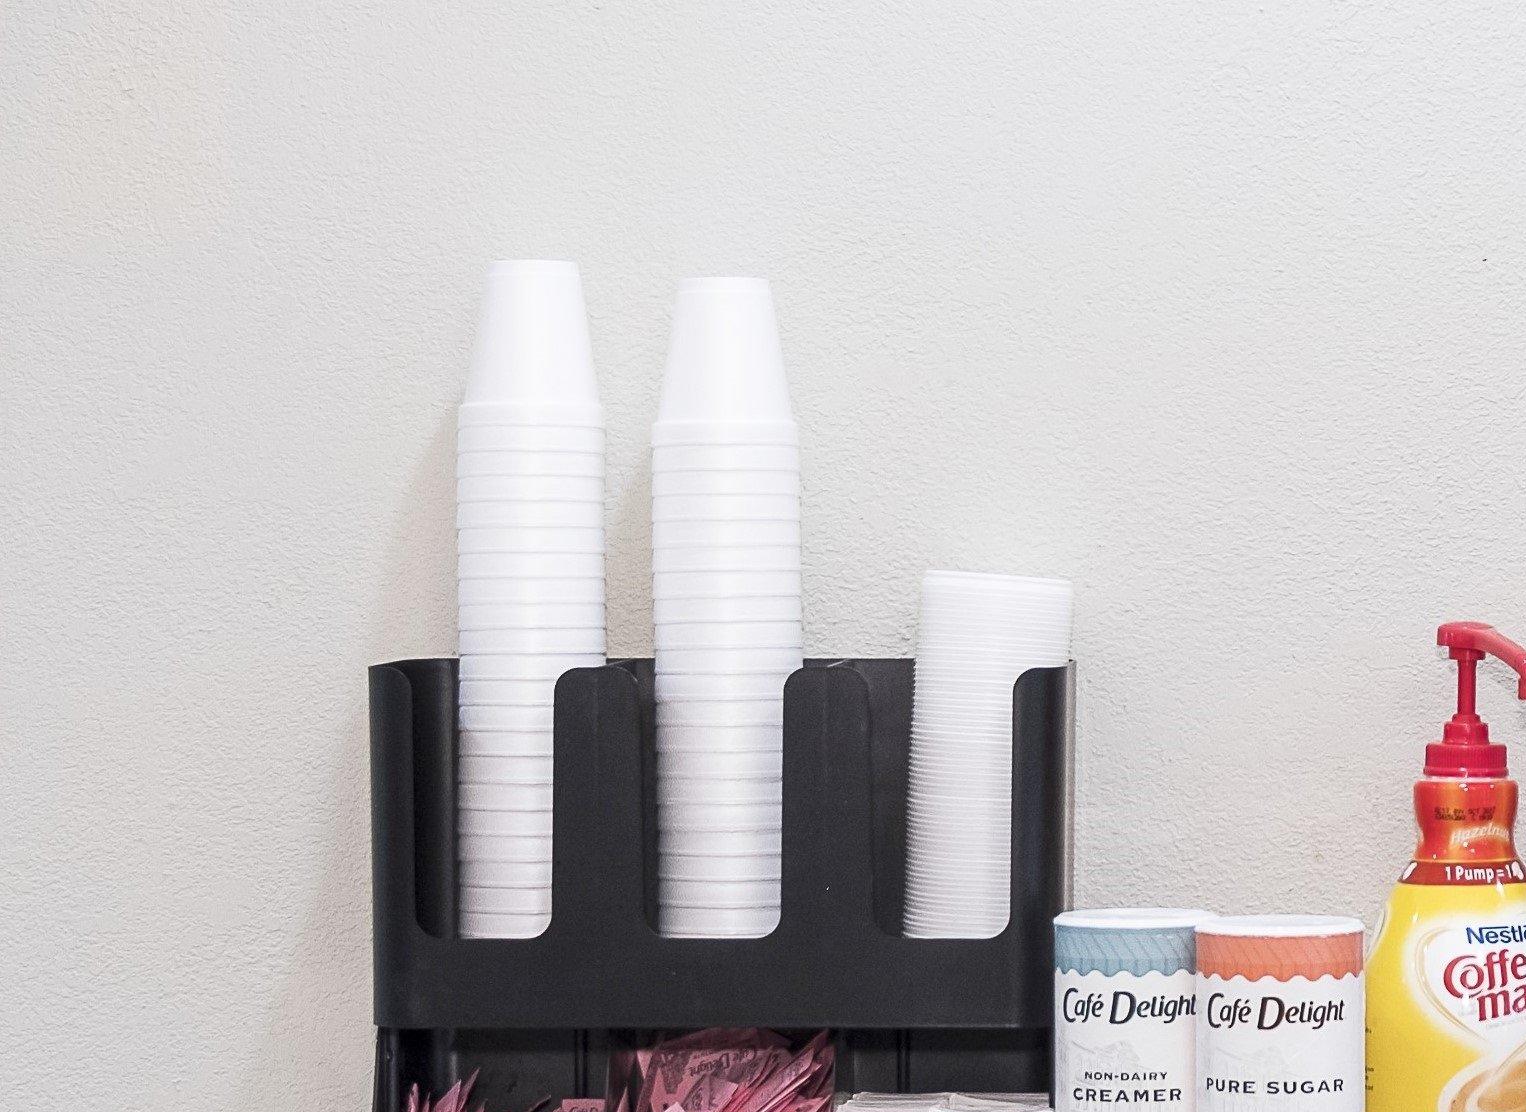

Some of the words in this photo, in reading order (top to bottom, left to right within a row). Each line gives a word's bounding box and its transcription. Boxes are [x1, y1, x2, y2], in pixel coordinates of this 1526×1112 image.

[1445, 867, 1451, 880] 1
[1456, 866, 1494, 883] Pump
[1063, 987, 1105, 1023] Café
[1109, 991, 1197, 1025] Delight
[1207, 992, 1252, 1028] Café
[1257, 996, 1345, 1031] Delight
[1084, 1071, 1168, 1082] NON-DAIRY
[1206, 1077, 1256, 1094] PURE
[1266, 1078, 1344, 1095] SUGAR
[1073, 1087, 1182, 1103] CREAMER
